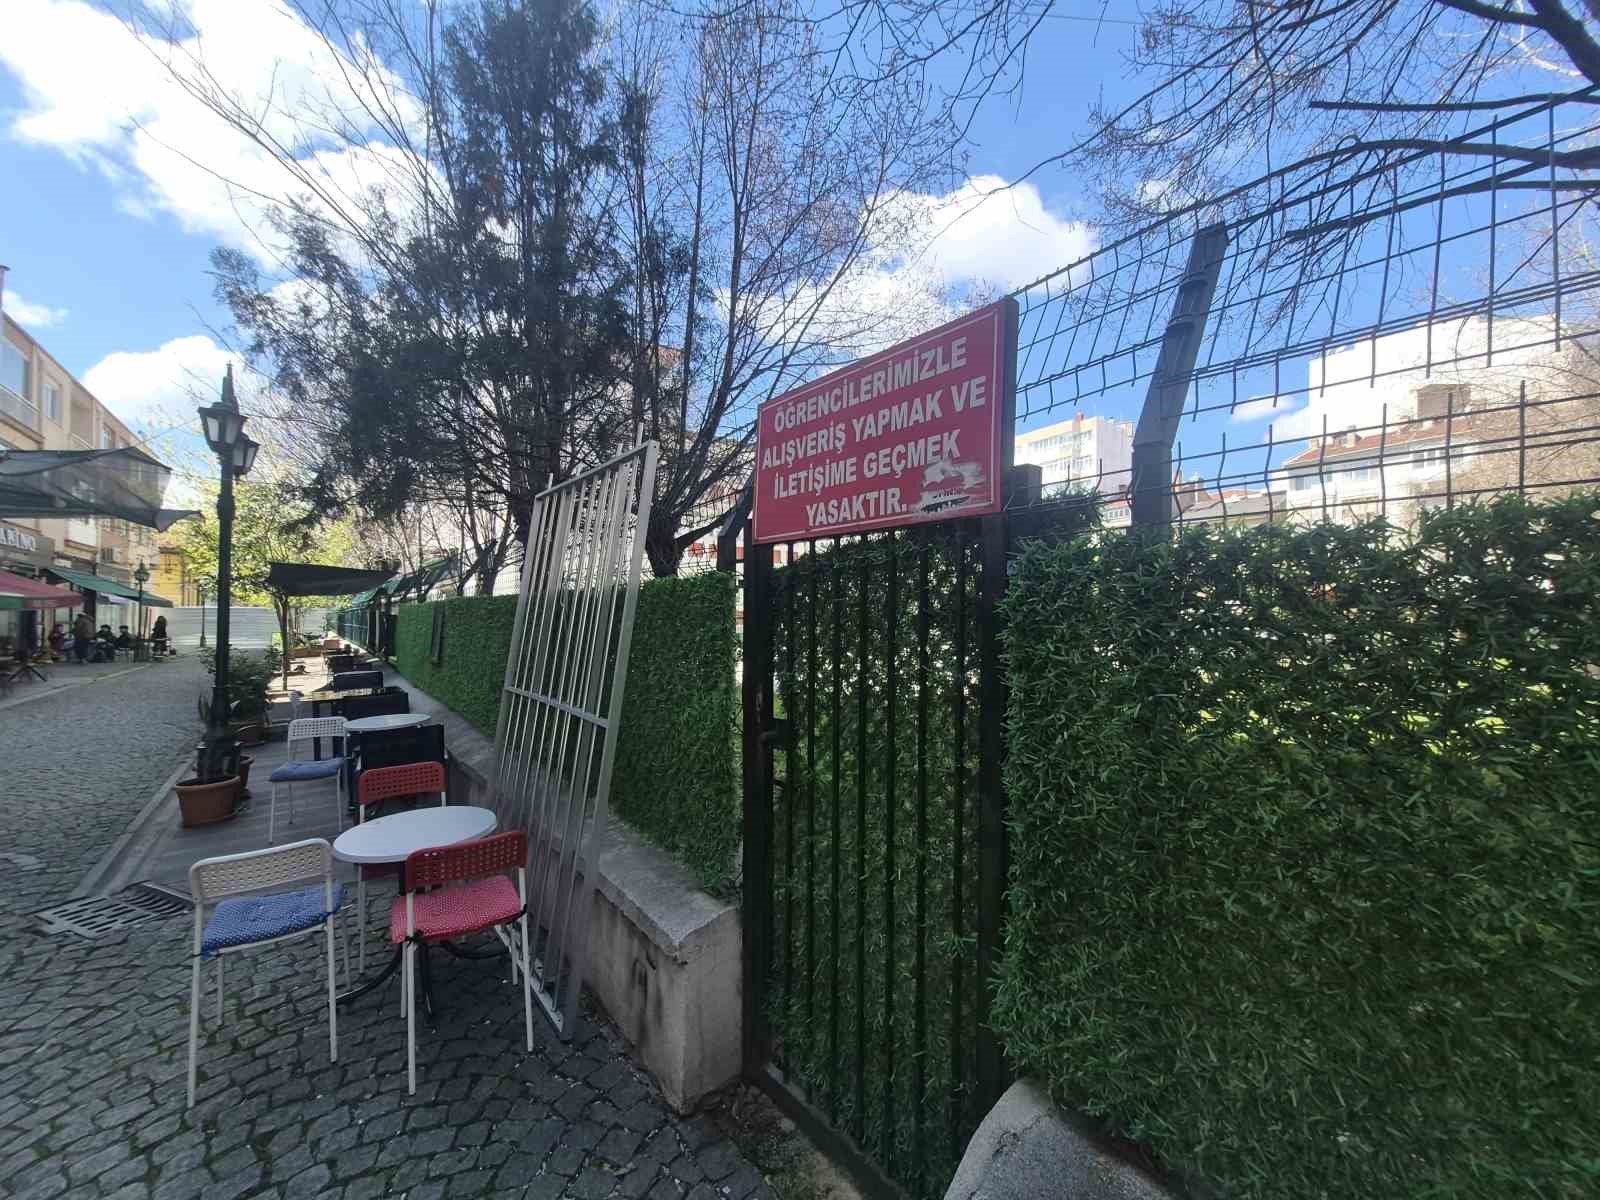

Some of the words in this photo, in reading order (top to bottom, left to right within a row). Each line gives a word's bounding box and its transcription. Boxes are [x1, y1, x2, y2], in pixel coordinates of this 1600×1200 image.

[762, 421, 846, 469] ALIŞVERİŞ
[852, 389, 943, 442] YAPMAK
[951, 376, 986, 412] VE
[774, 337, 967, 432] ÖĞRENCİLERİMİZLE
[774, 457, 857, 499] İLETİŞİME
[863, 429, 960, 478] GEÇMEK
[806, 487, 907, 527] YASAKTIR.
